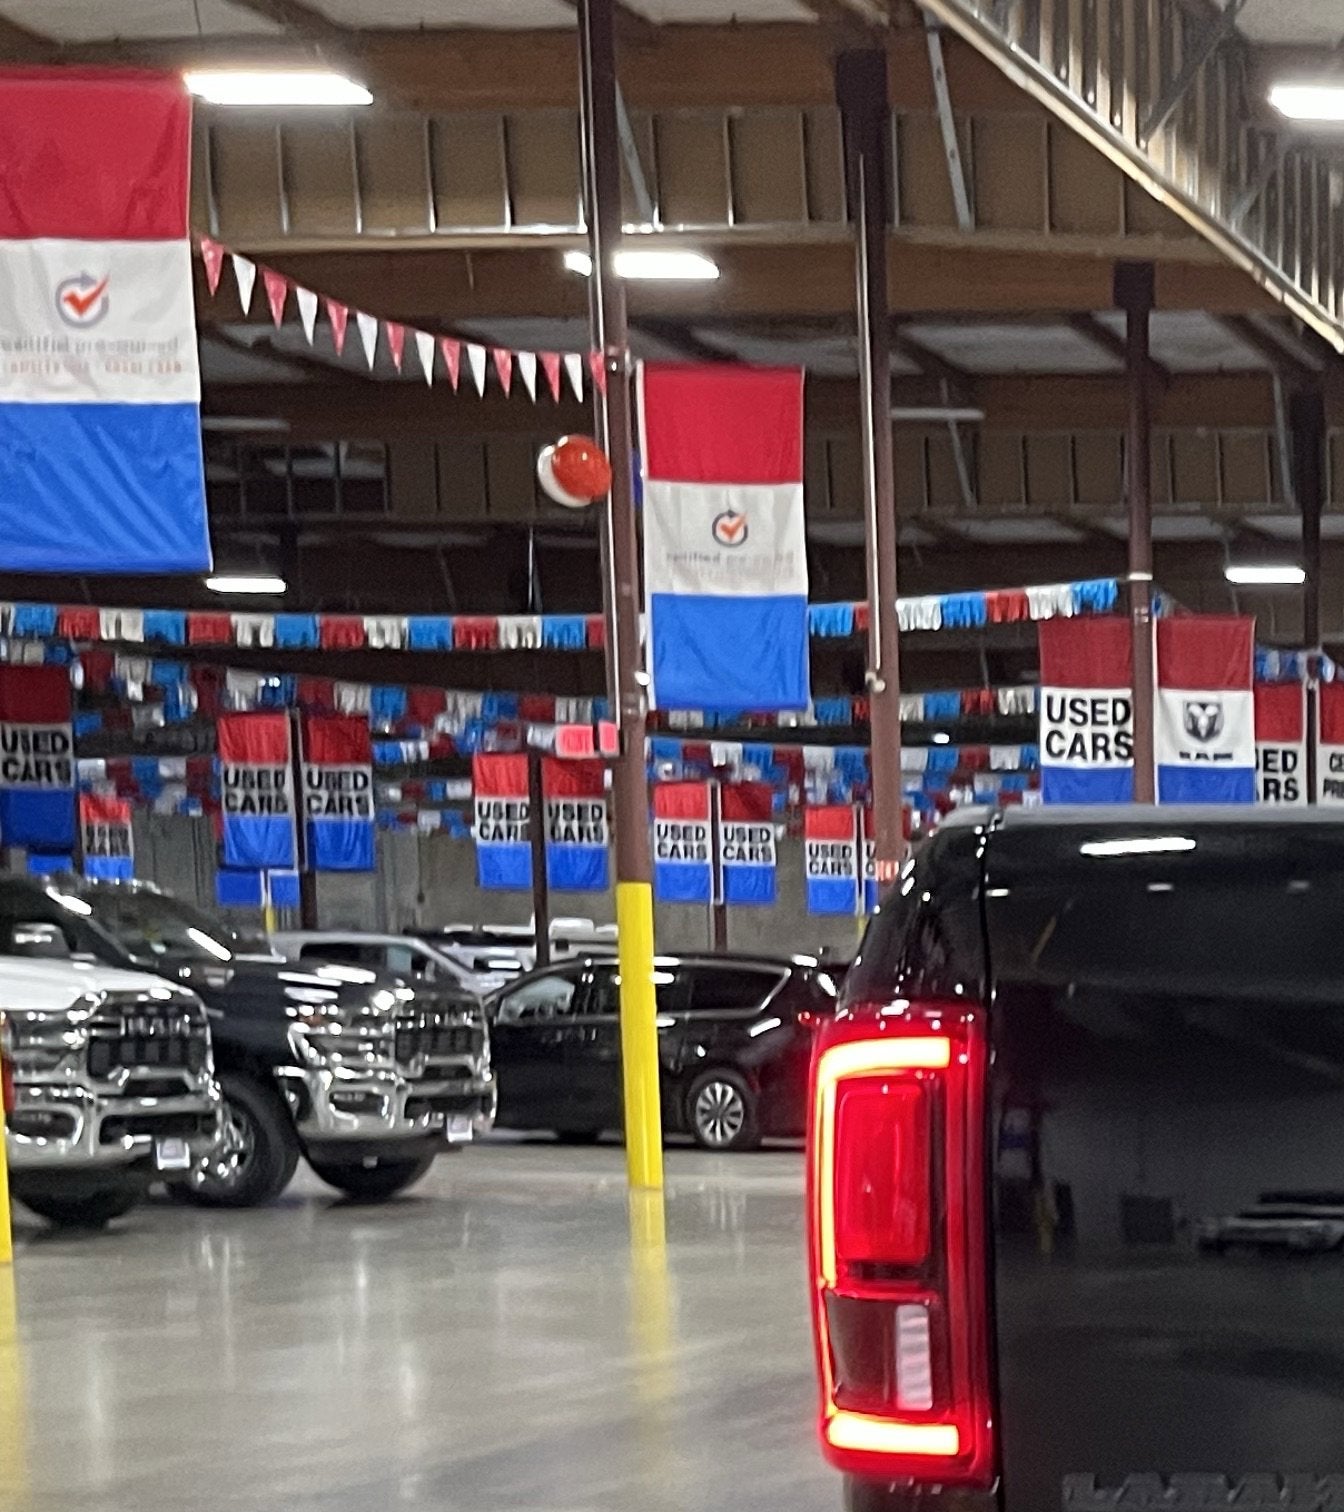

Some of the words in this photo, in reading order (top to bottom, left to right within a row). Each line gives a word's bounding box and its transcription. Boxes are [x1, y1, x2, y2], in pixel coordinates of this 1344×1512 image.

[1046, 695, 1132, 727] USED
[2, 729, 69, 753] USED
[1045, 730, 1133, 761] CARS
[2, 758, 71, 782] CARS
[1255, 749, 1298, 774] ED
[224, 769, 286, 790] USED
[307, 769, 369, 790] USED
[1255, 777, 1299, 801] RS
[225, 792, 288, 815] CARS
[307, 794, 370, 815] CARS
[478, 802, 529, 821] USED
[549, 803, 603, 822] USED
[657, 824, 706, 841] USED
[724, 825, 771, 843] USED
[657, 842, 707, 860] CARS
[723, 844, 772, 862] CARS
[808, 843, 850, 859] USED
[809, 860, 853, 876] CARS
